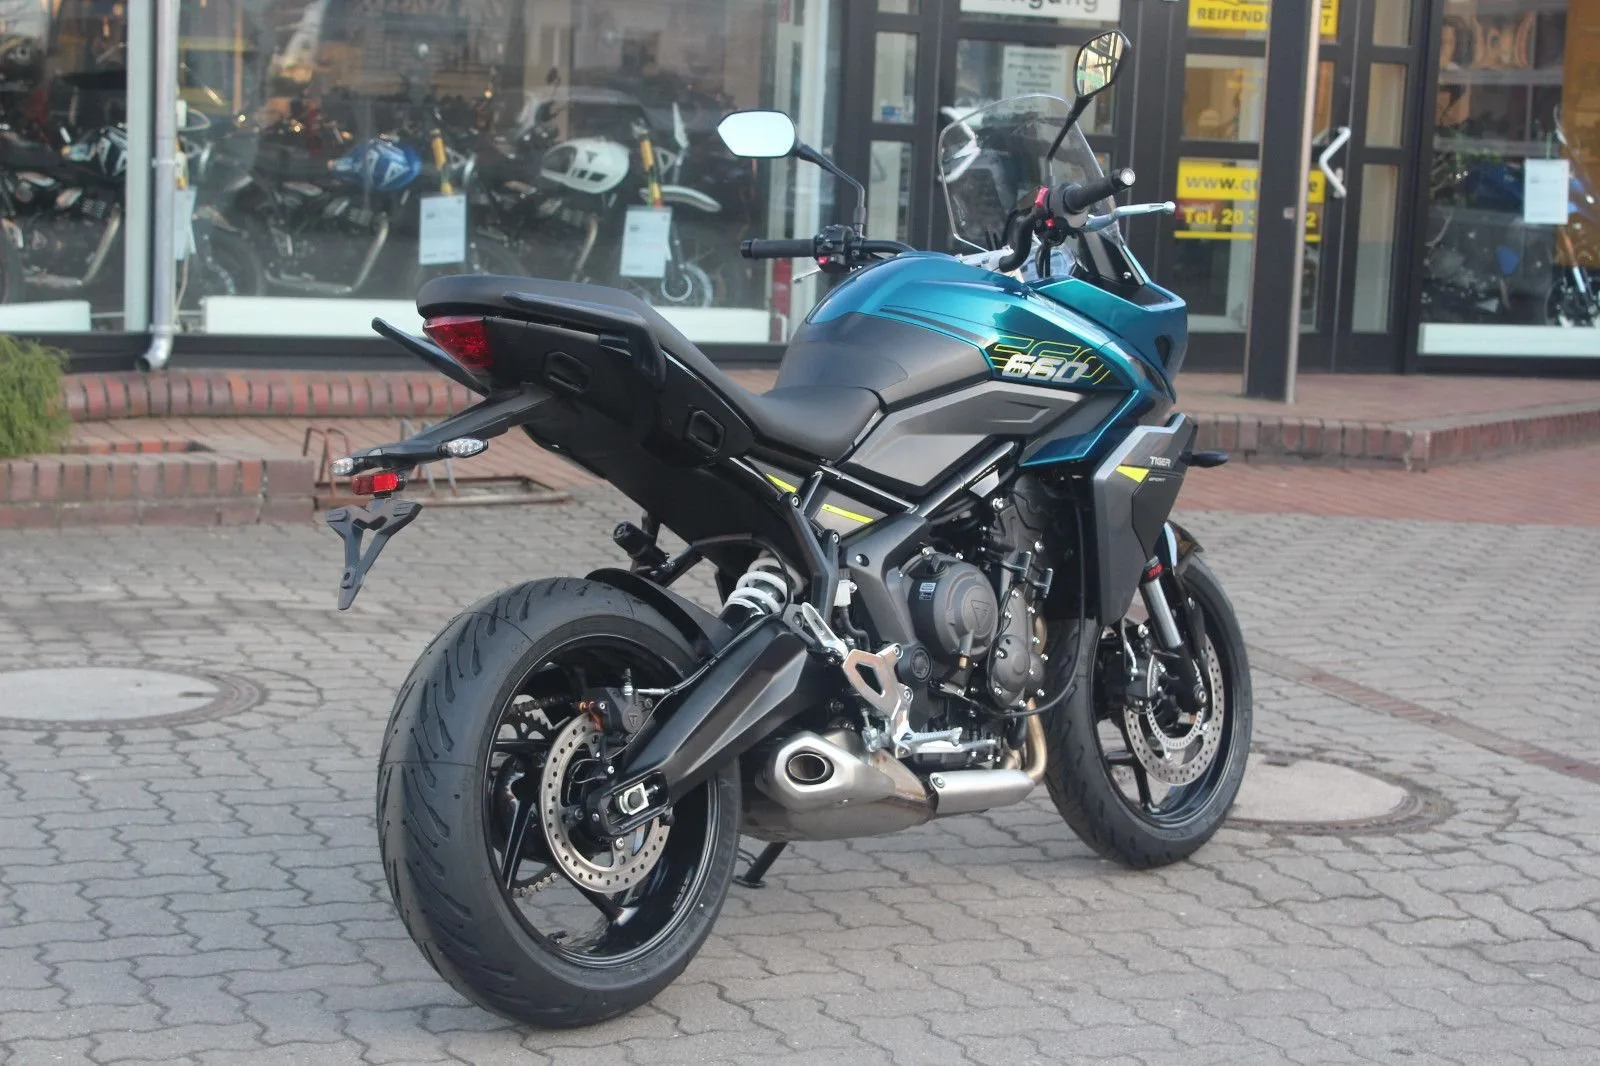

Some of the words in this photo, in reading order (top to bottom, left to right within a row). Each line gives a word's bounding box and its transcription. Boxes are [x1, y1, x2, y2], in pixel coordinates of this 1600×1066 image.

[1184, 207, 1217, 225] Tel.
[1221, 208, 1244, 225] 20
[1001, 353, 1089, 383] 660
[1149, 455, 1171, 467] TIGER
